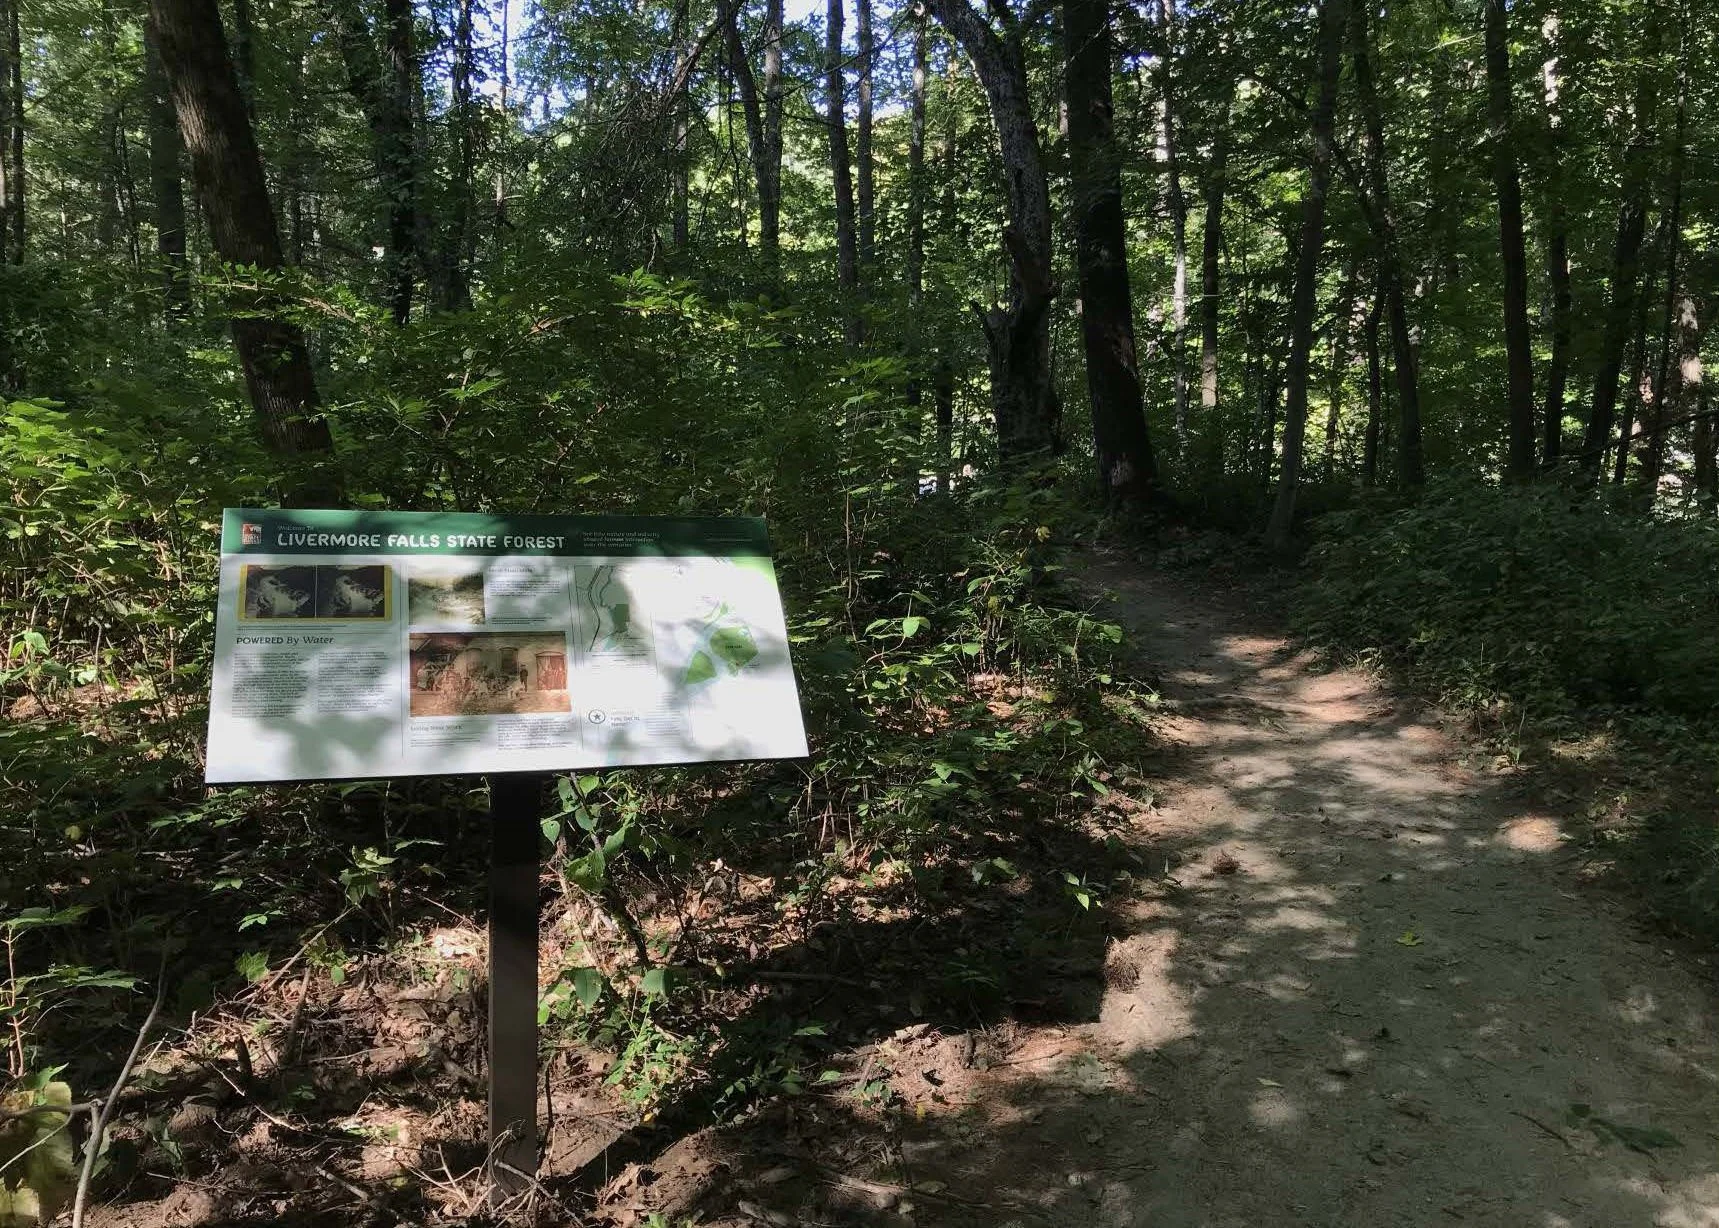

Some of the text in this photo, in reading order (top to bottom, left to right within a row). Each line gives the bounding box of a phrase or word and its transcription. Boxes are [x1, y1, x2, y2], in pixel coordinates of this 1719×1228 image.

[277, 533, 381, 547] LIVERMORE
[387, 534, 440, 548] FALLS
[446, 535, 497, 548] STATE
[503, 535, 565, 549] FOREST
[236, 636, 335, 646] POWERED By Water
